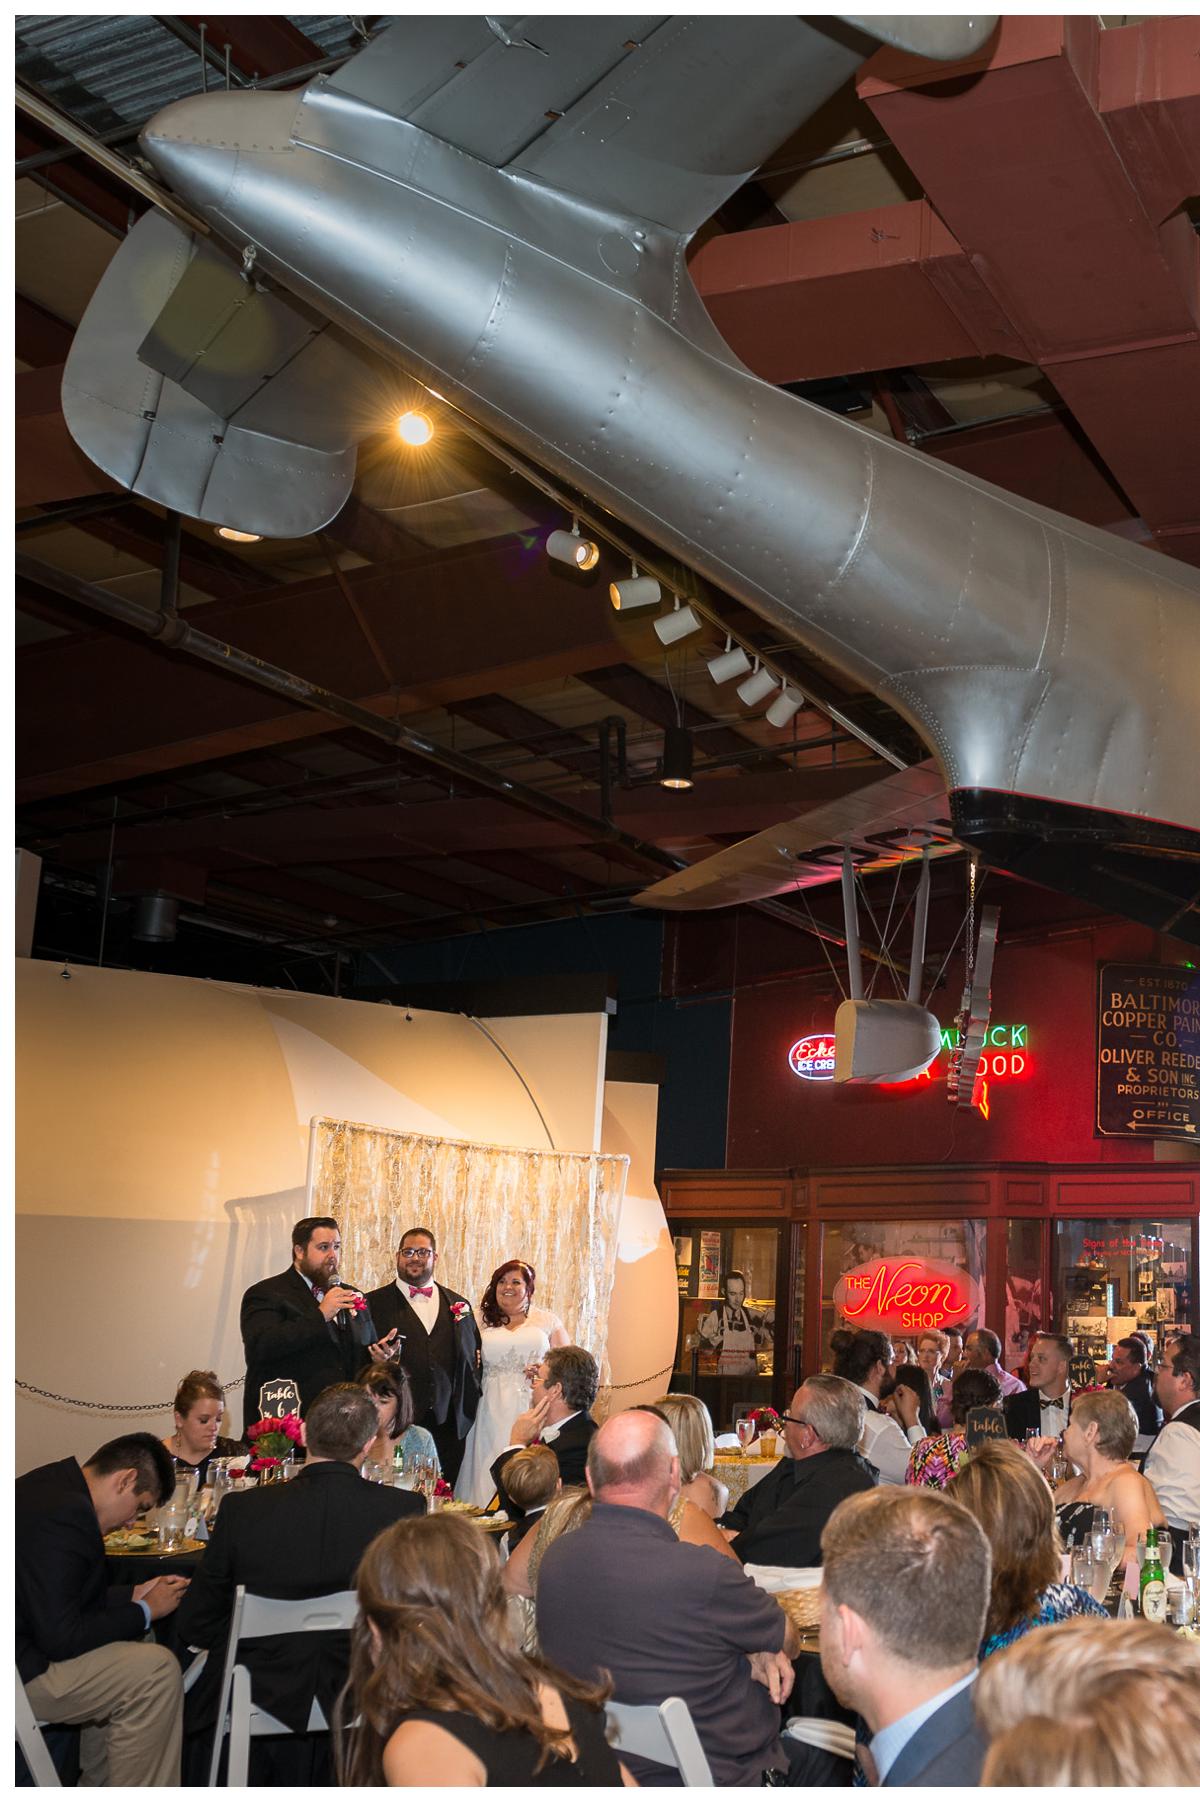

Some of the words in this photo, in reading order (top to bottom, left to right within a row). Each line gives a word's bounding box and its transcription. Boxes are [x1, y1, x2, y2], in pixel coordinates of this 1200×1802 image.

[1164, 979, 1188, 990] 1870
[1102, 1011, 1167, 1029] COPPER
[1153, 1032, 1182, 1047] CO.
[1100, 1049, 1155, 1065] OLIVER
[1126, 1067, 1141, 1083] &
[1147, 1068, 1178, 1085] SON
[1118, 1084, 1200, 1100] PROPRIETORS
[1133, 1109, 1190, 1122] OFFICE
[842, 1263, 967, 1315] Neon
[845, 1277, 871, 1289] THE
[902, 1313, 944, 1328] SHOP
[1071, 1361, 1092, 1371] table
[264, 1385, 295, 1401] table
[277, 1401, 285, 1418] 6
[972, 1416, 1004, 1434] table
